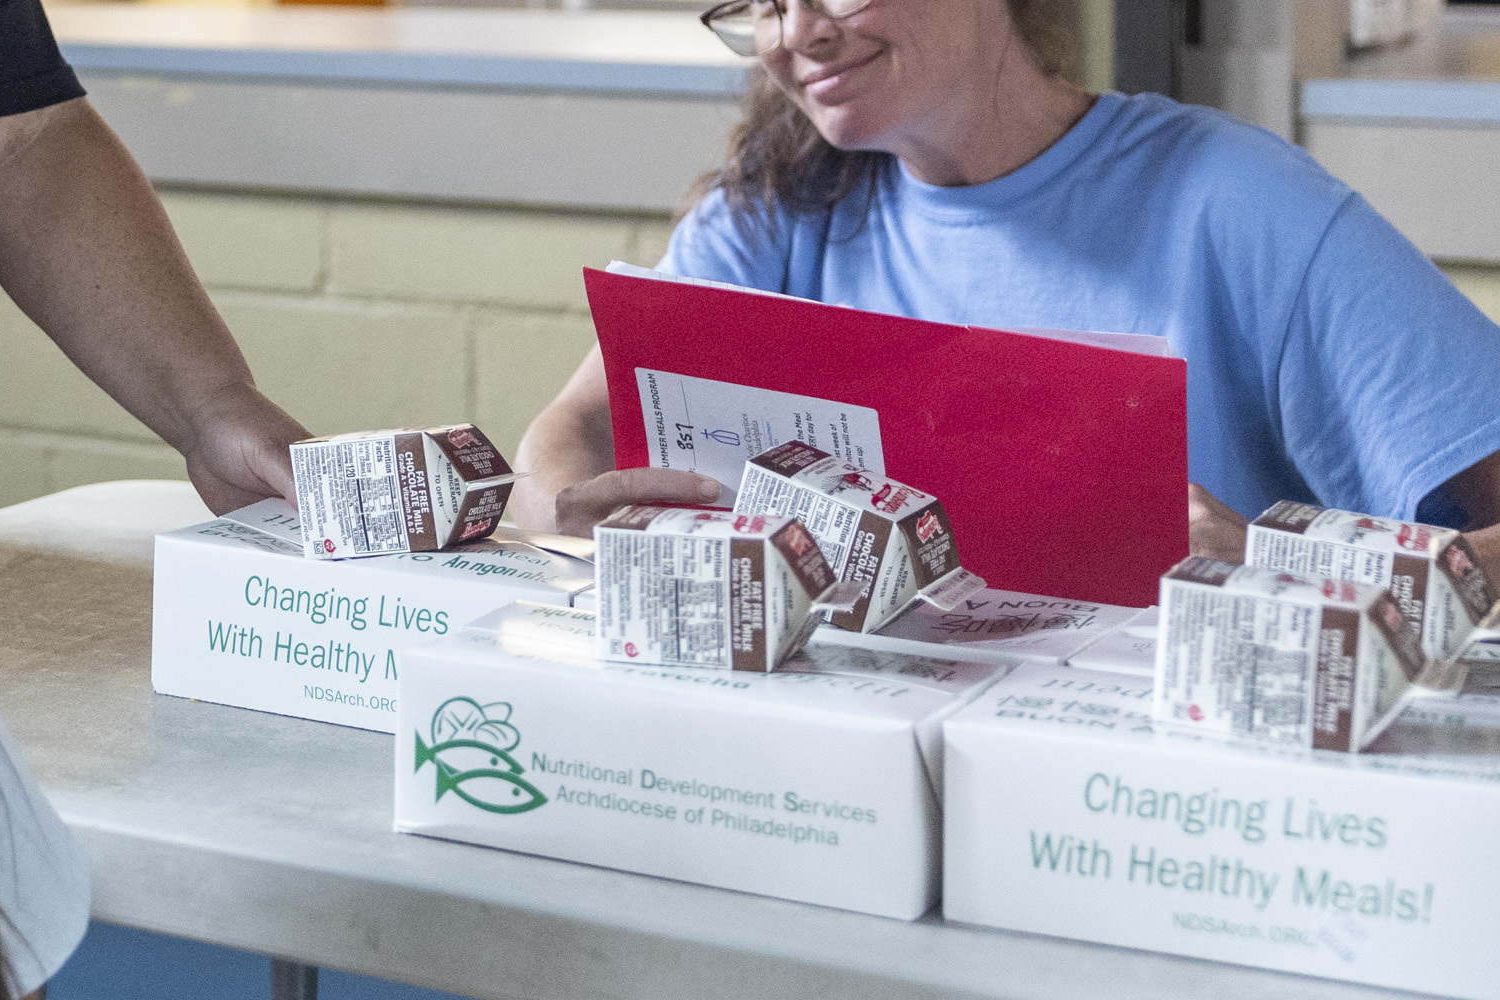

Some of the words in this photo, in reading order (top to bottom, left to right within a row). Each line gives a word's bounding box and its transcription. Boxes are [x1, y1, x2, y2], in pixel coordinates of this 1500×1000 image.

[647, 373, 662, 411] PROGRAM
[655, 411, 666, 440] MEALS
[793, 411, 802, 428] Meal
[806, 421, 815, 434] day
[839, 412, 846, 421] be
[808, 434, 816, 446] ERY
[831, 431, 839, 448] week
[842, 433, 850, 445] will
[346, 443, 355, 463] Calories
[360, 442, 371, 461] Serving
[374, 441, 384, 462] Facts
[381, 440, 394, 473] Nutrition
[657, 439, 669, 469] UMMER
[844, 446, 852, 461] nitor
[344, 464, 355, 477] 120
[415, 470, 425, 487] FAT
[434, 475, 441, 485] TO
[397, 453, 405, 473] Grade
[401, 486, 411, 512] Vitamin
[404, 451, 420, 507] CHOCOLATE
[412, 509, 423, 533] MILK
[446, 462, 459, 514] REFRIGERATED
[454, 478, 462, 496] KEEP
[418, 489, 429, 512] FREE
[435, 486, 445, 508] OPEN
[804, 492, 815, 514] Calories
[795, 510, 807, 523] 12
[820, 498, 833, 521] Serving
[833, 505, 847, 529] Facts
[818, 520, 827, 533] Size
[838, 508, 856, 544] Nutrition
[704, 538, 713, 563] Facts
[853, 529, 865, 551] Grade
[489, 549, 551, 566] Meal
[713, 539, 723, 577] Nutrition
[851, 550, 859, 558] A
[853, 530, 874, 582] CHOCOLAT
[865, 554, 878, 574] FAT
[441, 554, 469, 569] Ăn
[469, 560, 517, 576] ngon
[516, 568, 555, 584] nhé
[887, 565, 894, 577] TO
[900, 570, 909, 589] KEEP
[739, 557, 752, 620] CHOCOLATE
[751, 580, 762, 600] FAT
[881, 577, 890, 598] OPEN
[245, 574, 368, 631] Changing
[379, 593, 449, 636] Lives
[751, 602, 762, 629] FREE
[741, 622, 752, 651] MILK
[207, 619, 263, 659] With
[273, 630, 376, 685] Healthy
[531, 751, 634, 786] Nutritional
[639, 769, 776, 810] Development
[783, 791, 878, 826] Services
[555, 784, 678, 822] Archdiocese
[684, 807, 705, 825] of
[711, 809, 840, 847] Philadelphia
[1082, 770, 1269, 843] Changing
[1282, 797, 1389, 849] Lives
[1028, 829, 1114, 880] With
[1126, 844, 1280, 911] Healthy
[1290, 864, 1436, 924] Meals!
